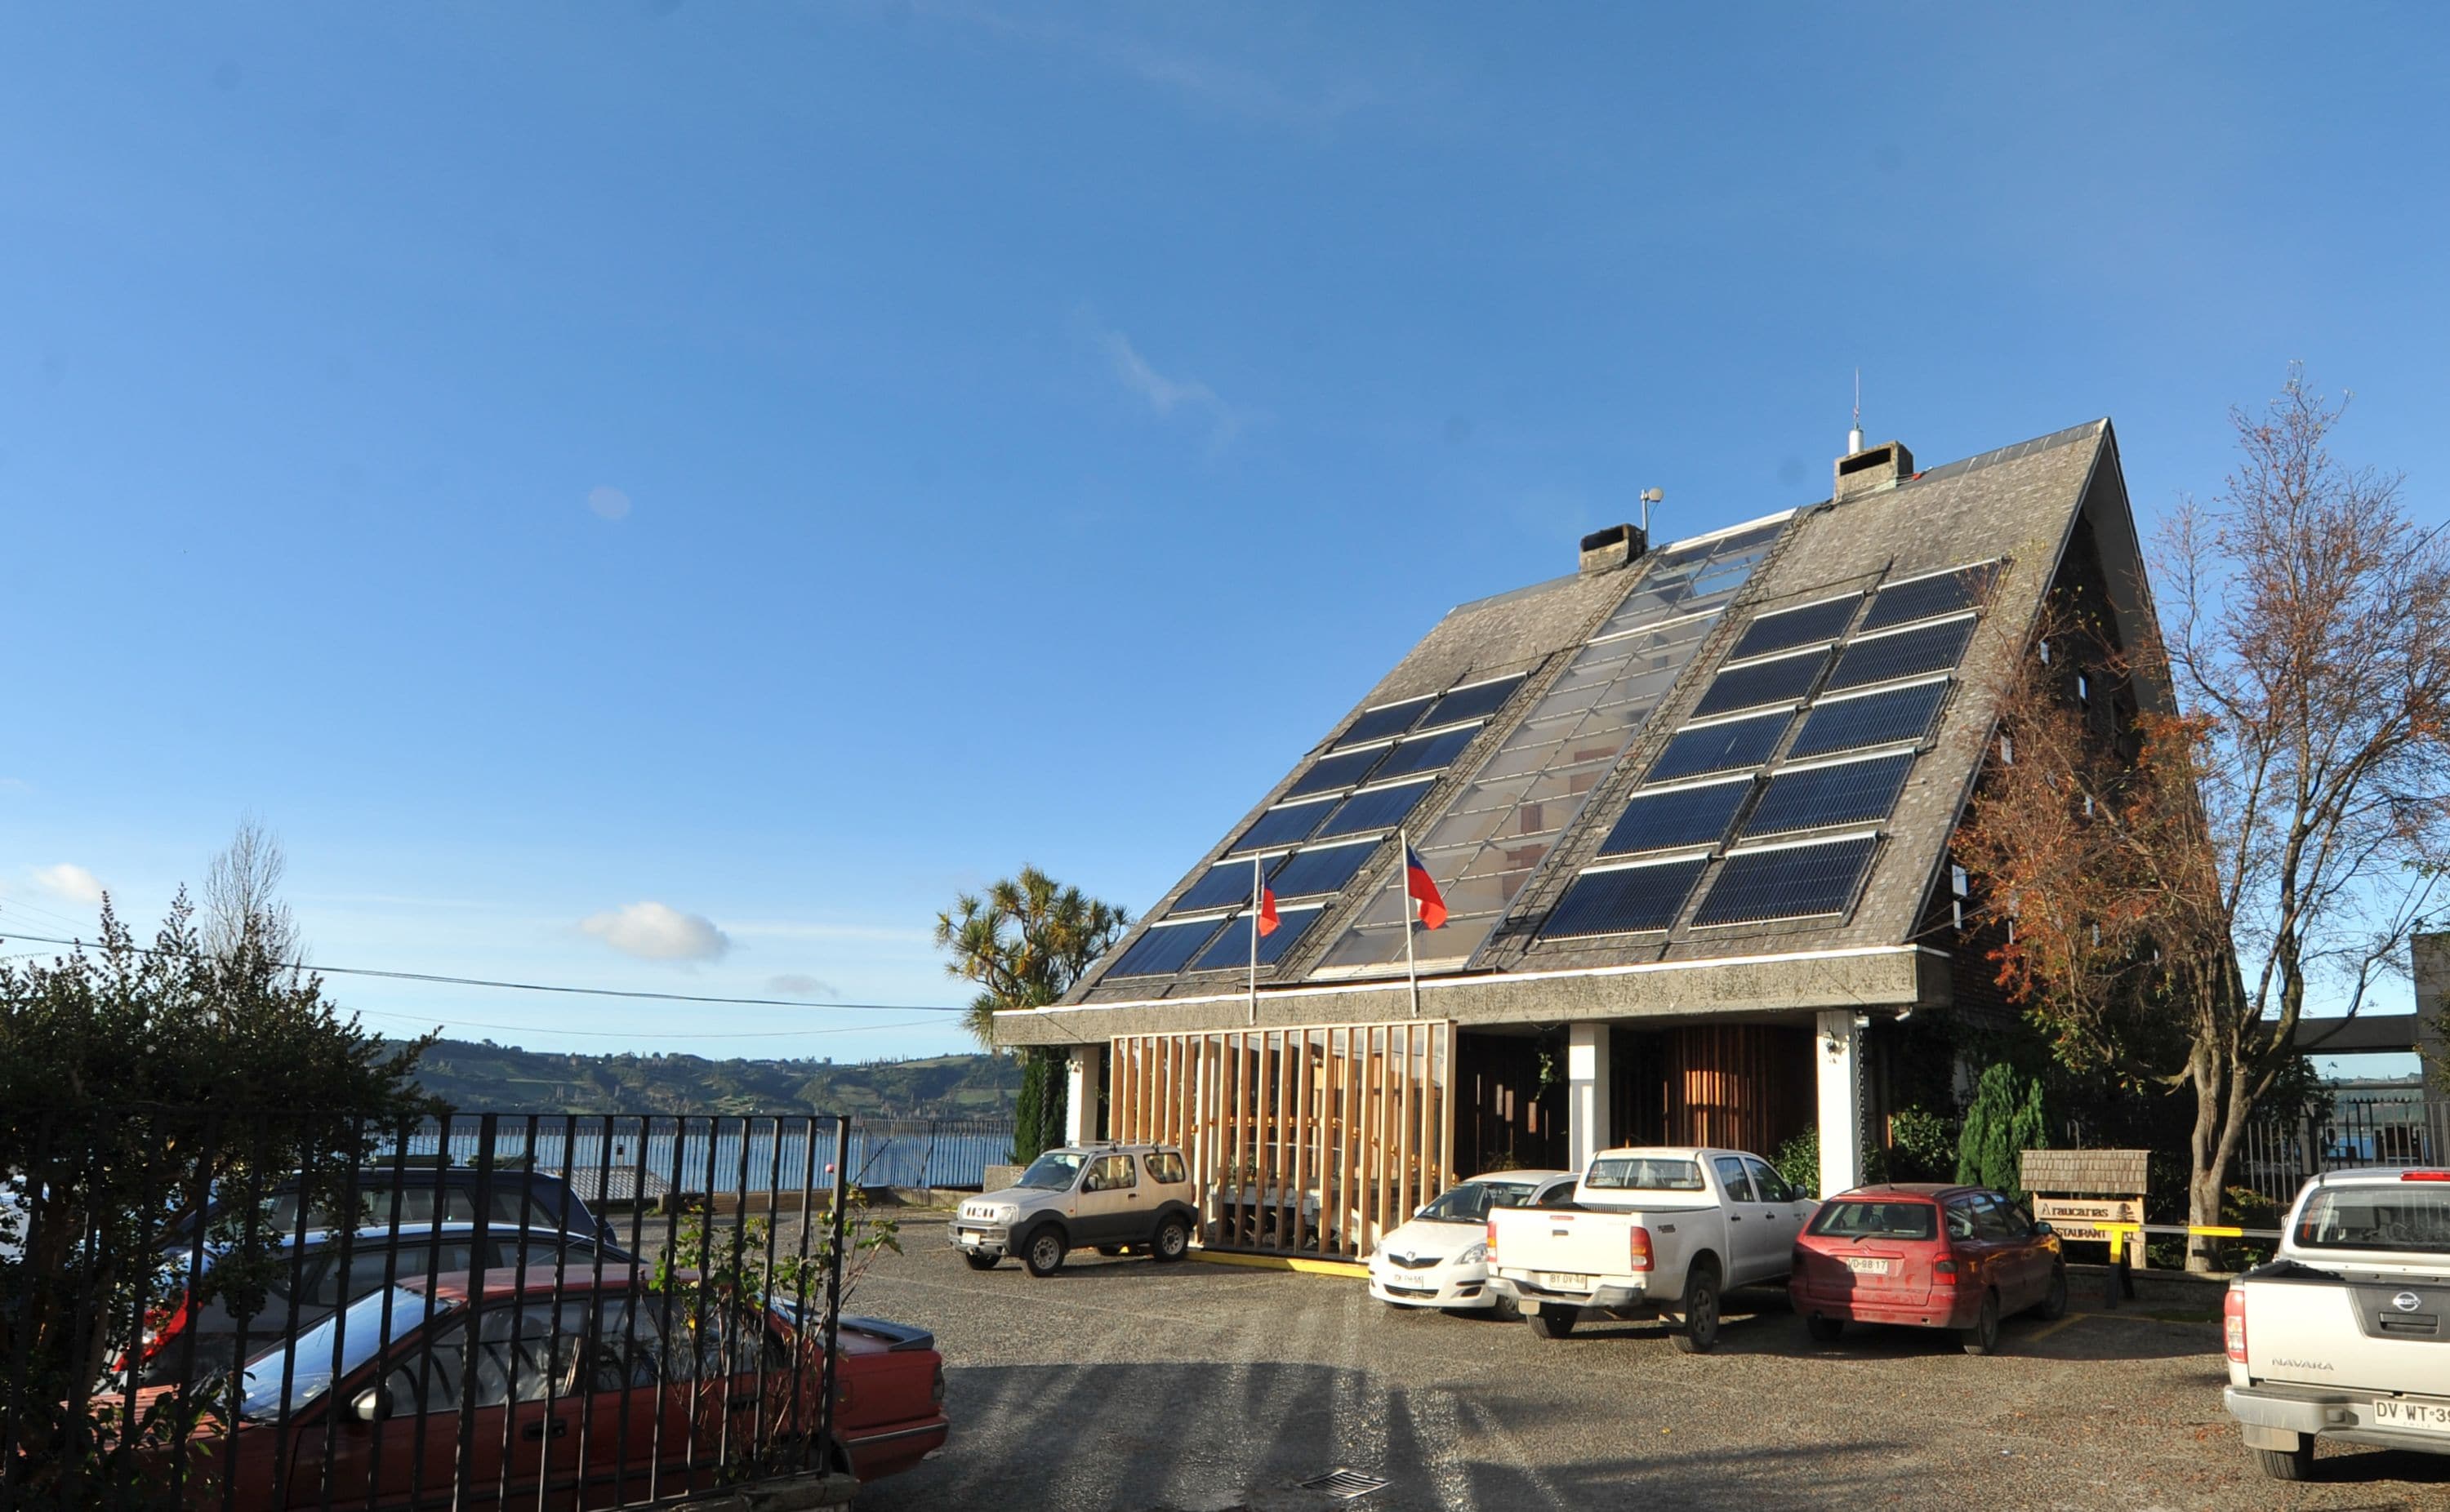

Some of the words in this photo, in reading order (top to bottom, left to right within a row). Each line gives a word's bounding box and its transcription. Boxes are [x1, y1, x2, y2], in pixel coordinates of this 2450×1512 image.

[2041, 1203, 2109, 1217] Araucarias
[2053, 1227, 2106, 1239] STAURANT
[2272, 1358, 2334, 1371] NAVARA
